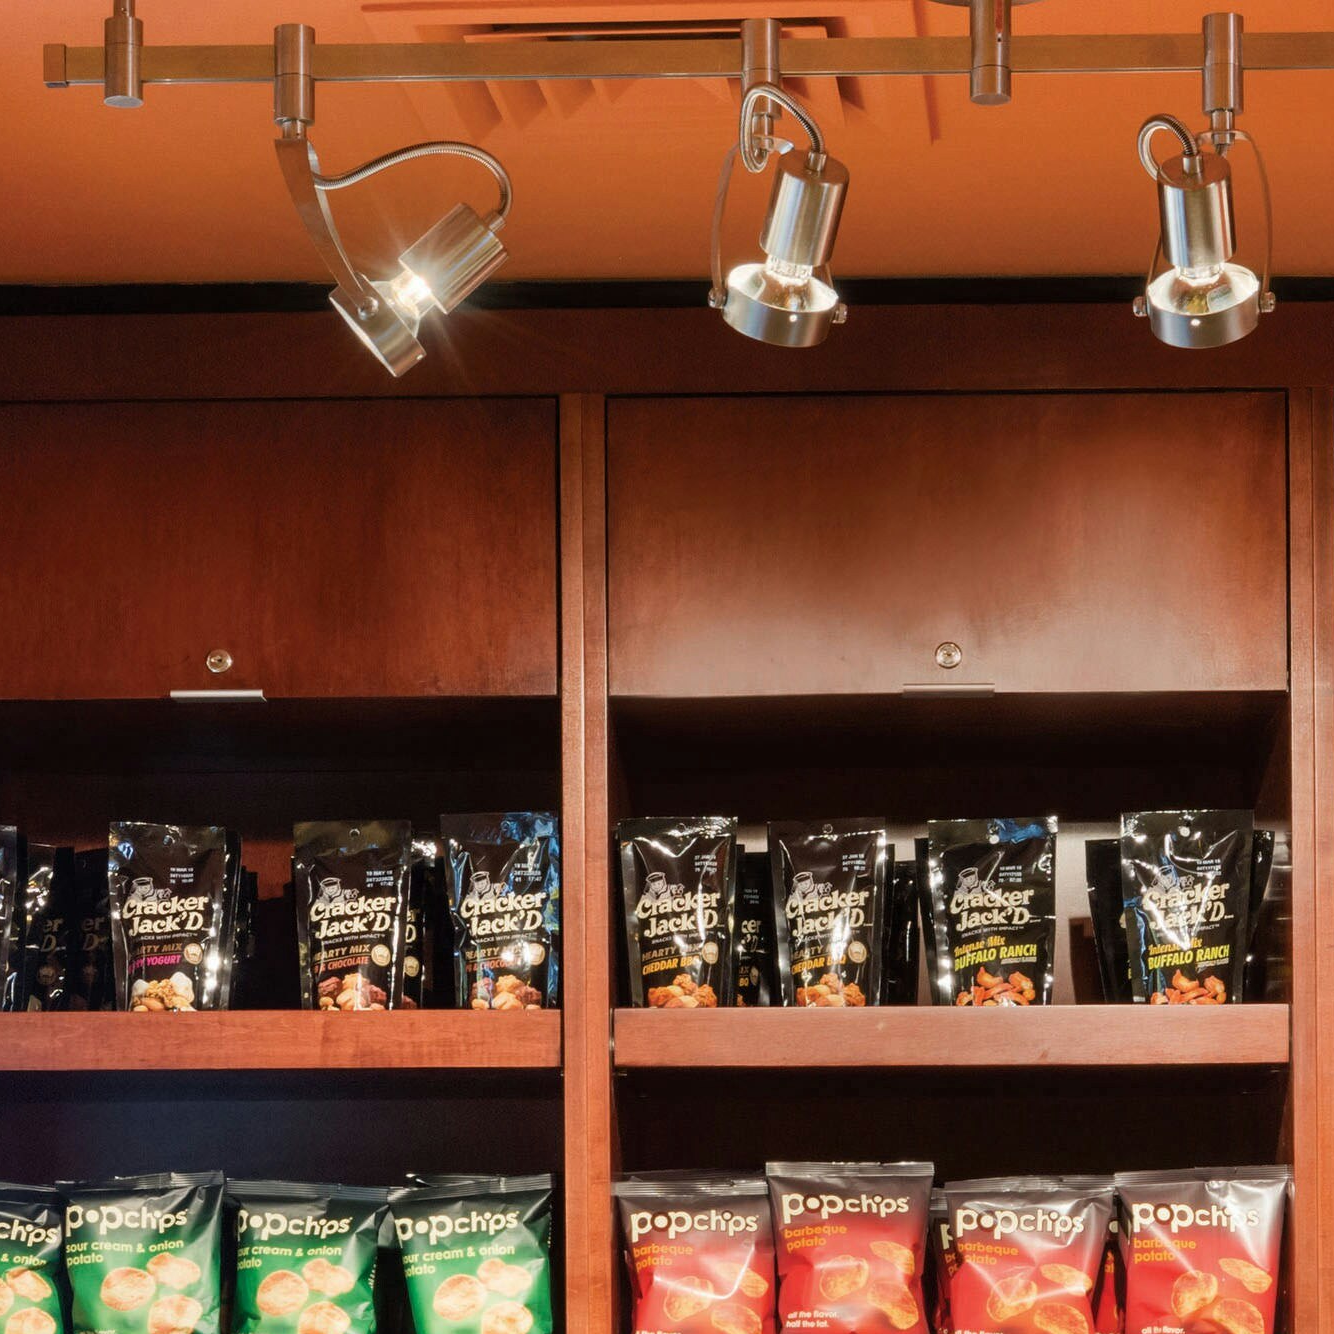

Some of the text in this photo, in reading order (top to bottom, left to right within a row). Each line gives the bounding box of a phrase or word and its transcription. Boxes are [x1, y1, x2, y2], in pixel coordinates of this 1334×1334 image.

[122, 895, 209, 919] Cracker
[310, 896, 396, 922] Cracker
[460, 891, 546, 917] Cracker
[635, 891, 720, 918] Cracker
[785, 890, 869, 919] Cracker
[950, 889, 1034, 914] Cracker
[129, 914, 204, 936] Jack'D
[315, 913, 390, 939] Jack'D
[956, 908, 1030, 931] Jack'D
[987, 936, 1005, 947] Mix
[147, 955, 181, 966] YOGURT
[643, 959, 678, 975] CHEDDAR
[955, 949, 996, 971] BUFFALO
[1000, 945, 1037, 958] RANCH
[1148, 945, 1229, 969] BUFFALO RANCH
[782, 1193, 908, 1224] popchips
[1133, 1202, 1259, 1234] popchips
[66, 1205, 187, 1237] popchips
[395, 1211, 518, 1248] popchips
[630, 1211, 758, 1242] popchips
[784, 1225, 847, 1239] barbeque
[957, 1208, 1083, 1240] popchips
[92, 1240, 184, 1252] cream onion
[252, 1246, 341, 1256] cream onion
[423, 1244, 515, 1262] cream onion
[633, 1243, 693, 1258] barbeque
[787, 1237, 826, 1252] potato
[1134, 1238, 1196, 1250] barbeque
[67, 1253, 103, 1267] potato
[636, 1256, 672, 1270] potato
[1134, 1250, 1176, 1263] potato
[786, 1320, 800, 1328] half
